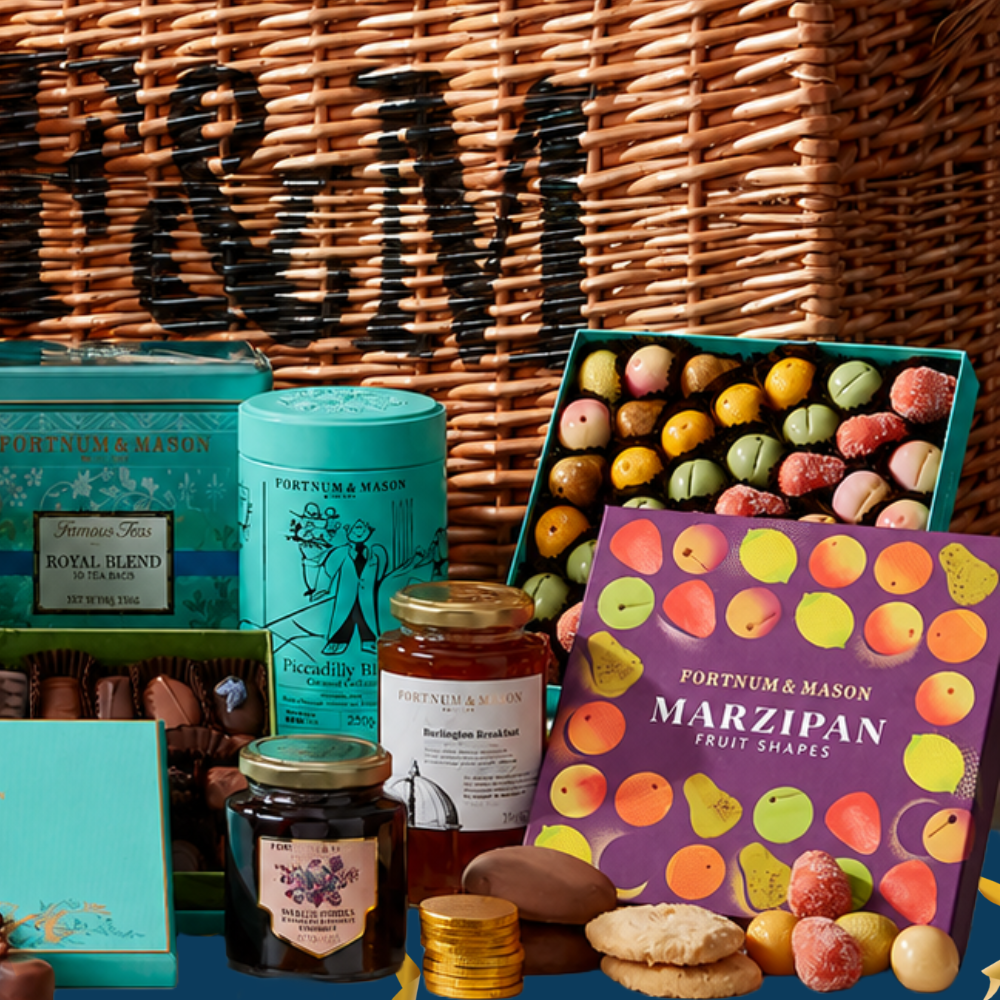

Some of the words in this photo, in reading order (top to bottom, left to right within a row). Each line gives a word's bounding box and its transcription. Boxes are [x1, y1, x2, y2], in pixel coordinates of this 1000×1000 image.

[0, 435, 109, 454] FORTNUM
[114, 436, 128, 453] &
[134, 435, 211, 453] MASON
[275, 477, 343, 493] FORTNUM
[346, 482, 356, 493] &
[360, 478, 407, 493] MASON
[46, 555, 100, 569] ROYAL
[105, 554, 162, 569] BLEND
[87, 571, 105, 581] TEA
[283, 658, 356, 681] Piccadilly
[679, 669, 779, 693] FORTNUM
[782, 679, 796, 694] &
[800, 680, 873, 701] MASON
[398, 690, 462, 705] FORTNUM
[464, 694, 476, 706] &
[650, 695, 887, 745] MARZIPAN
[694, 733, 750, 750] FRUIT
[757, 738, 831, 759] SHAPES
